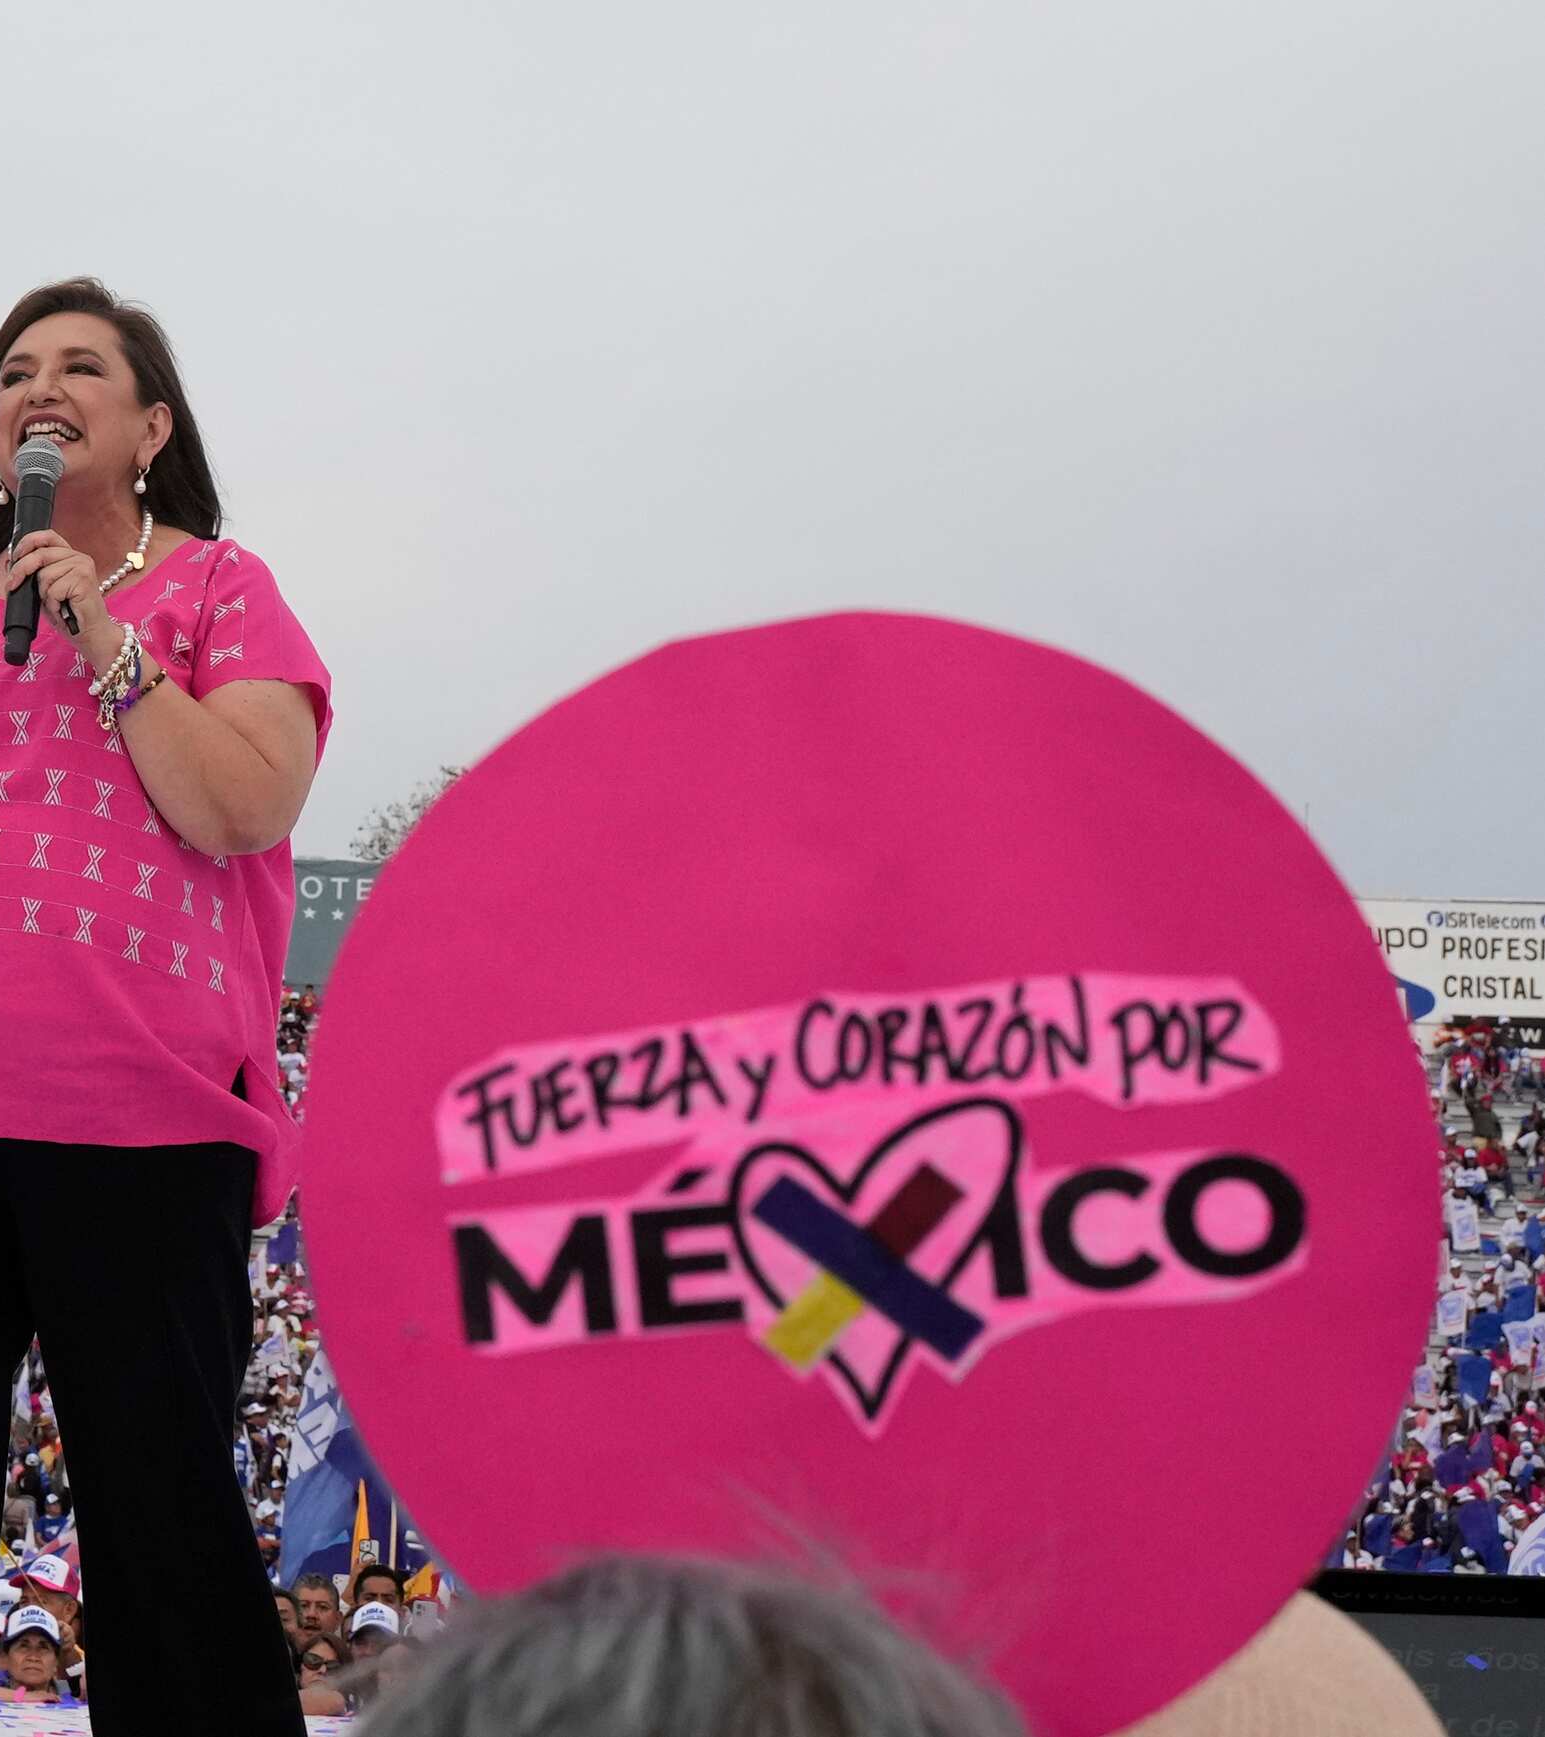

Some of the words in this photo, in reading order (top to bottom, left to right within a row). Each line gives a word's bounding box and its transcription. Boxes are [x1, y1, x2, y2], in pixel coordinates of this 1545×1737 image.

[1443, 975, 1543, 1000] CRISTAL
[457, 1030, 727, 1170] FUERZA
[794, 975, 1092, 1091] CORAZÓN
